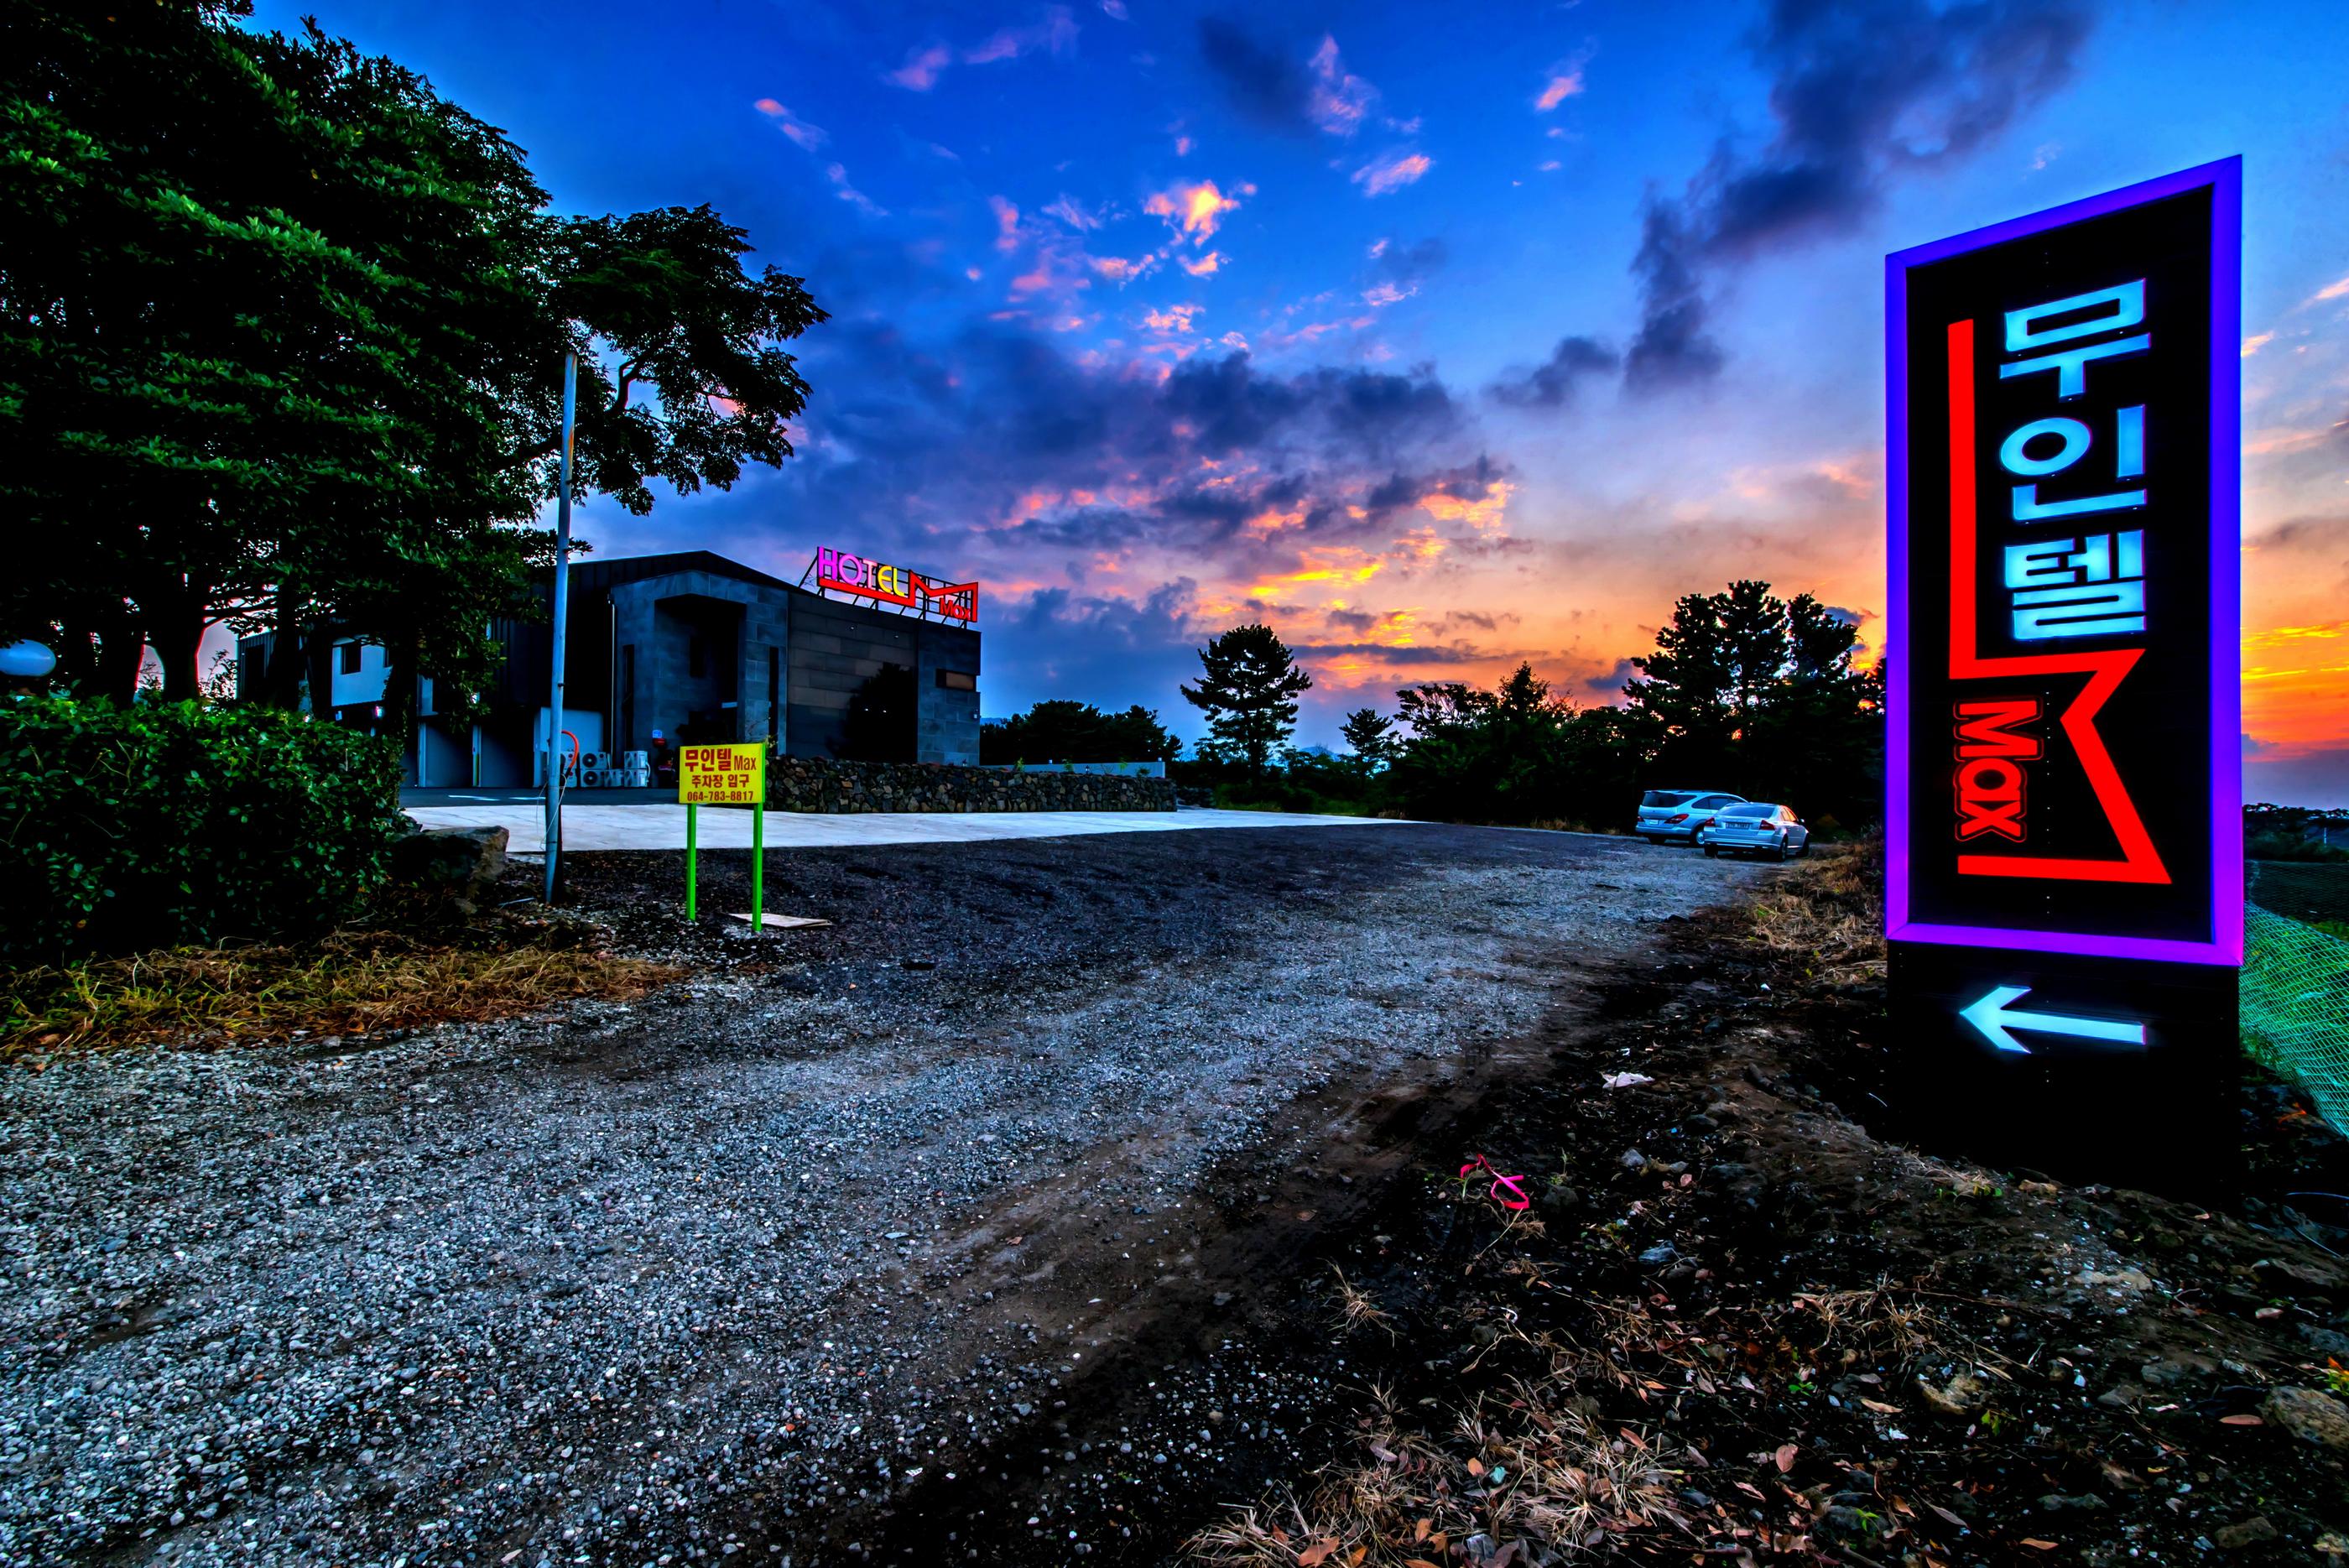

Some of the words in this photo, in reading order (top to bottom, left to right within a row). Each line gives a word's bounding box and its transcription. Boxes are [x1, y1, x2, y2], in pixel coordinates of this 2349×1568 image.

[1999, 278, 2150, 640] 무인텔
[819, 546, 905, 597] HOTEL
[940, 597, 971, 621] Max
[685, 748, 732, 772] 무인텔
[734, 755, 757, 770] Max
[1957, 700, 2039, 838] Max
[691, 774, 723, 789] 주차장
[727, 774, 750, 788] 입구
[687, 791, 754, 801] 064-783-8817
